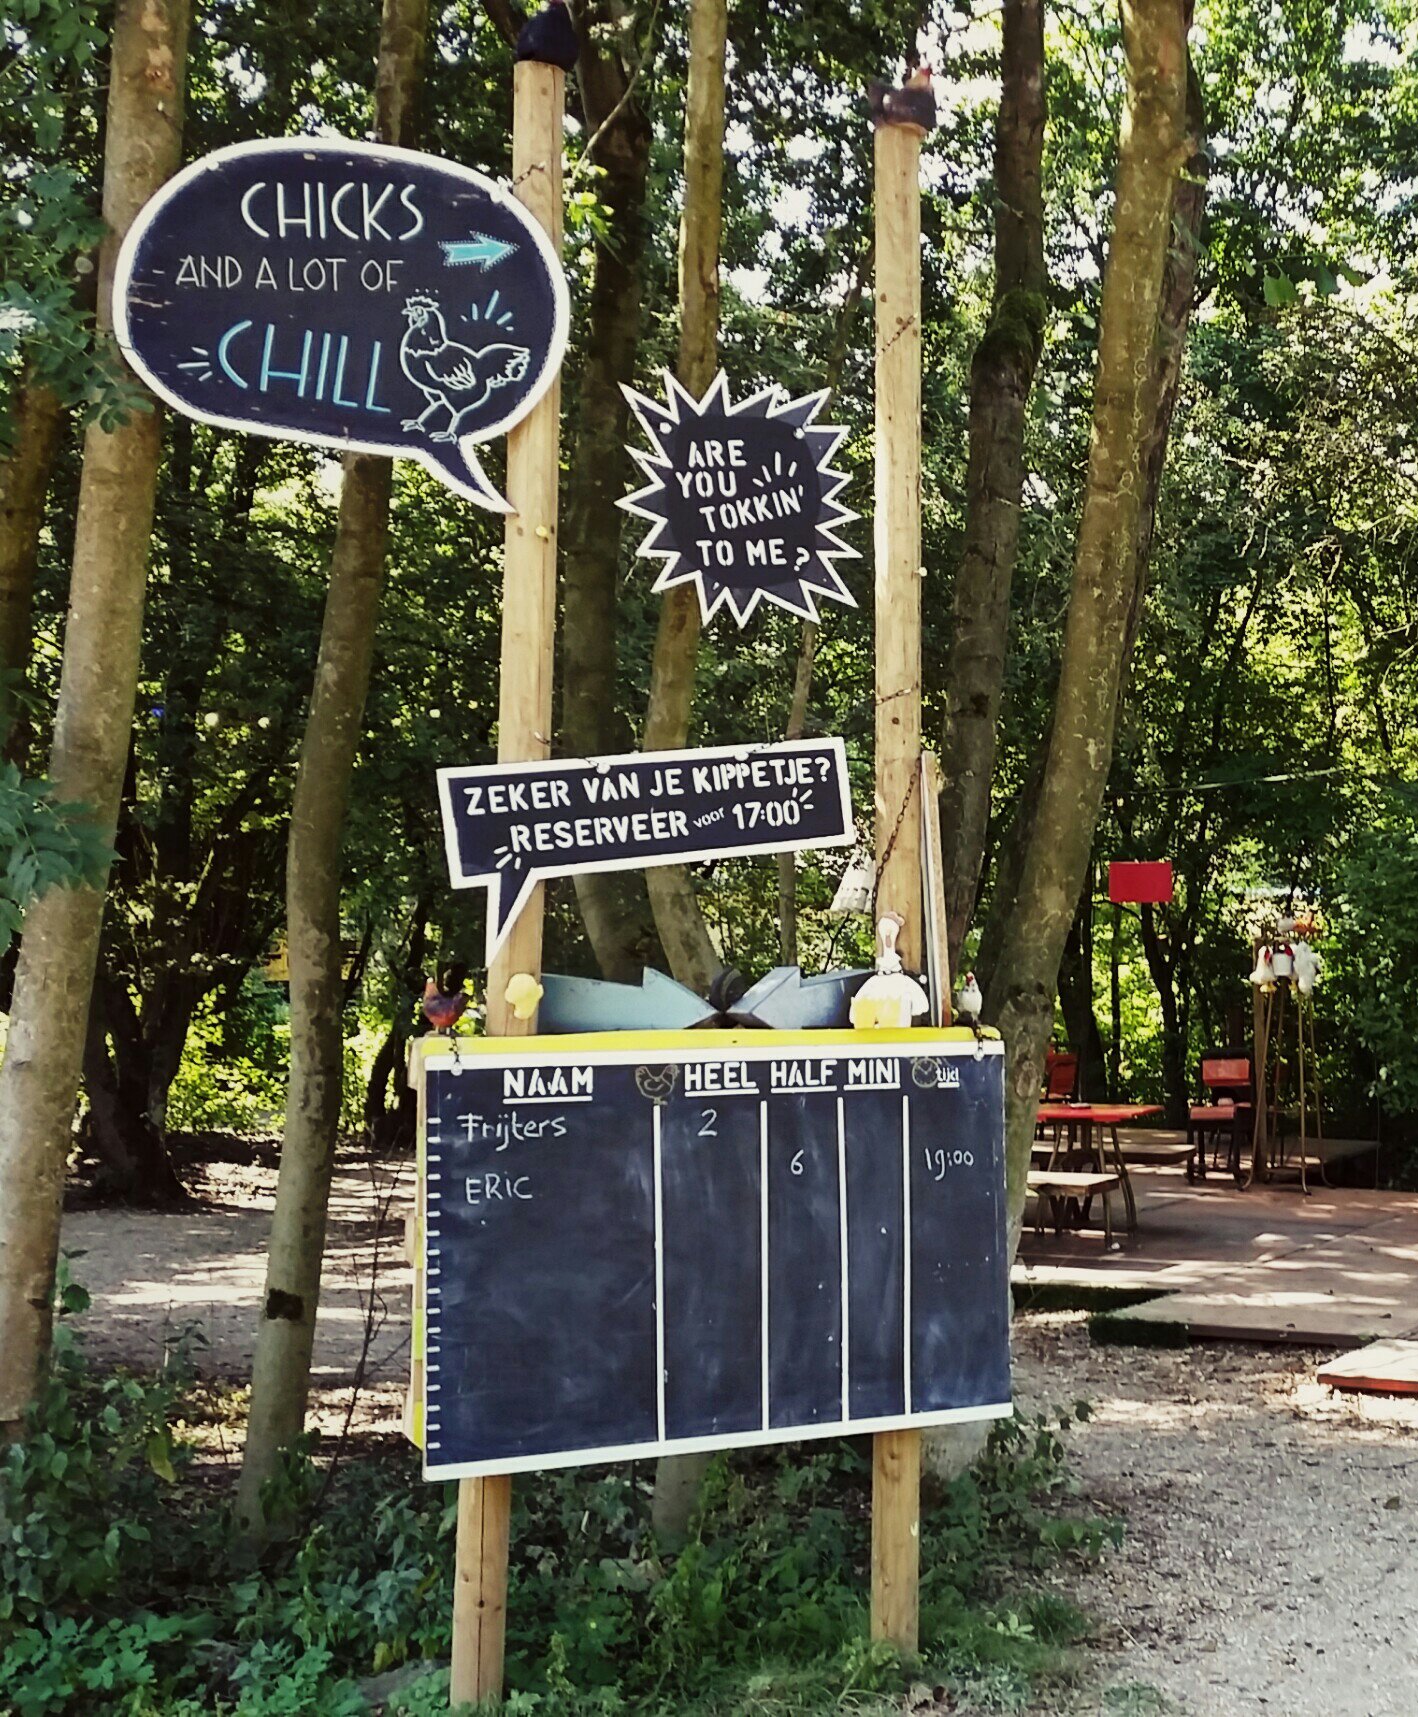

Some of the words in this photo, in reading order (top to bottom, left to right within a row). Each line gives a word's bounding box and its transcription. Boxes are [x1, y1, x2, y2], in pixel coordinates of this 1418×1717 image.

[240, 181, 425, 241] CHICKS
[175, 254, 242, 289] AND
[254, 256, 278, 290] A
[288, 257, 347, 293] LOT
[360, 259, 404, 293] OF
[217, 319, 392, 414] CHILL
[688, 439, 748, 469] ARE
[675, 470, 737, 499] YOU
[696, 540, 735, 567] TO
[463, 779, 571, 817] ZEKER
[581, 771, 641, 801] VAN
[649, 768, 684, 797] JE
[692, 756, 832, 794] KIPPETJE?
[509, 809, 690, 854] RESERVEER
[692, 808, 725, 829] voor
[731, 799, 801, 831] 17:00
[503, 1066, 595, 1098] NAAM
[684, 1060, 758, 1090] HEEL
[771, 1059, 838, 1087] HALF
[847, 1057, 901, 1085] MINI
[456, 1111, 567, 1151] Frijters
[698, 1108, 718, 1137] 2
[790, 1149, 805, 1175] 6
[924, 1147, 975, 1181] 19:00
